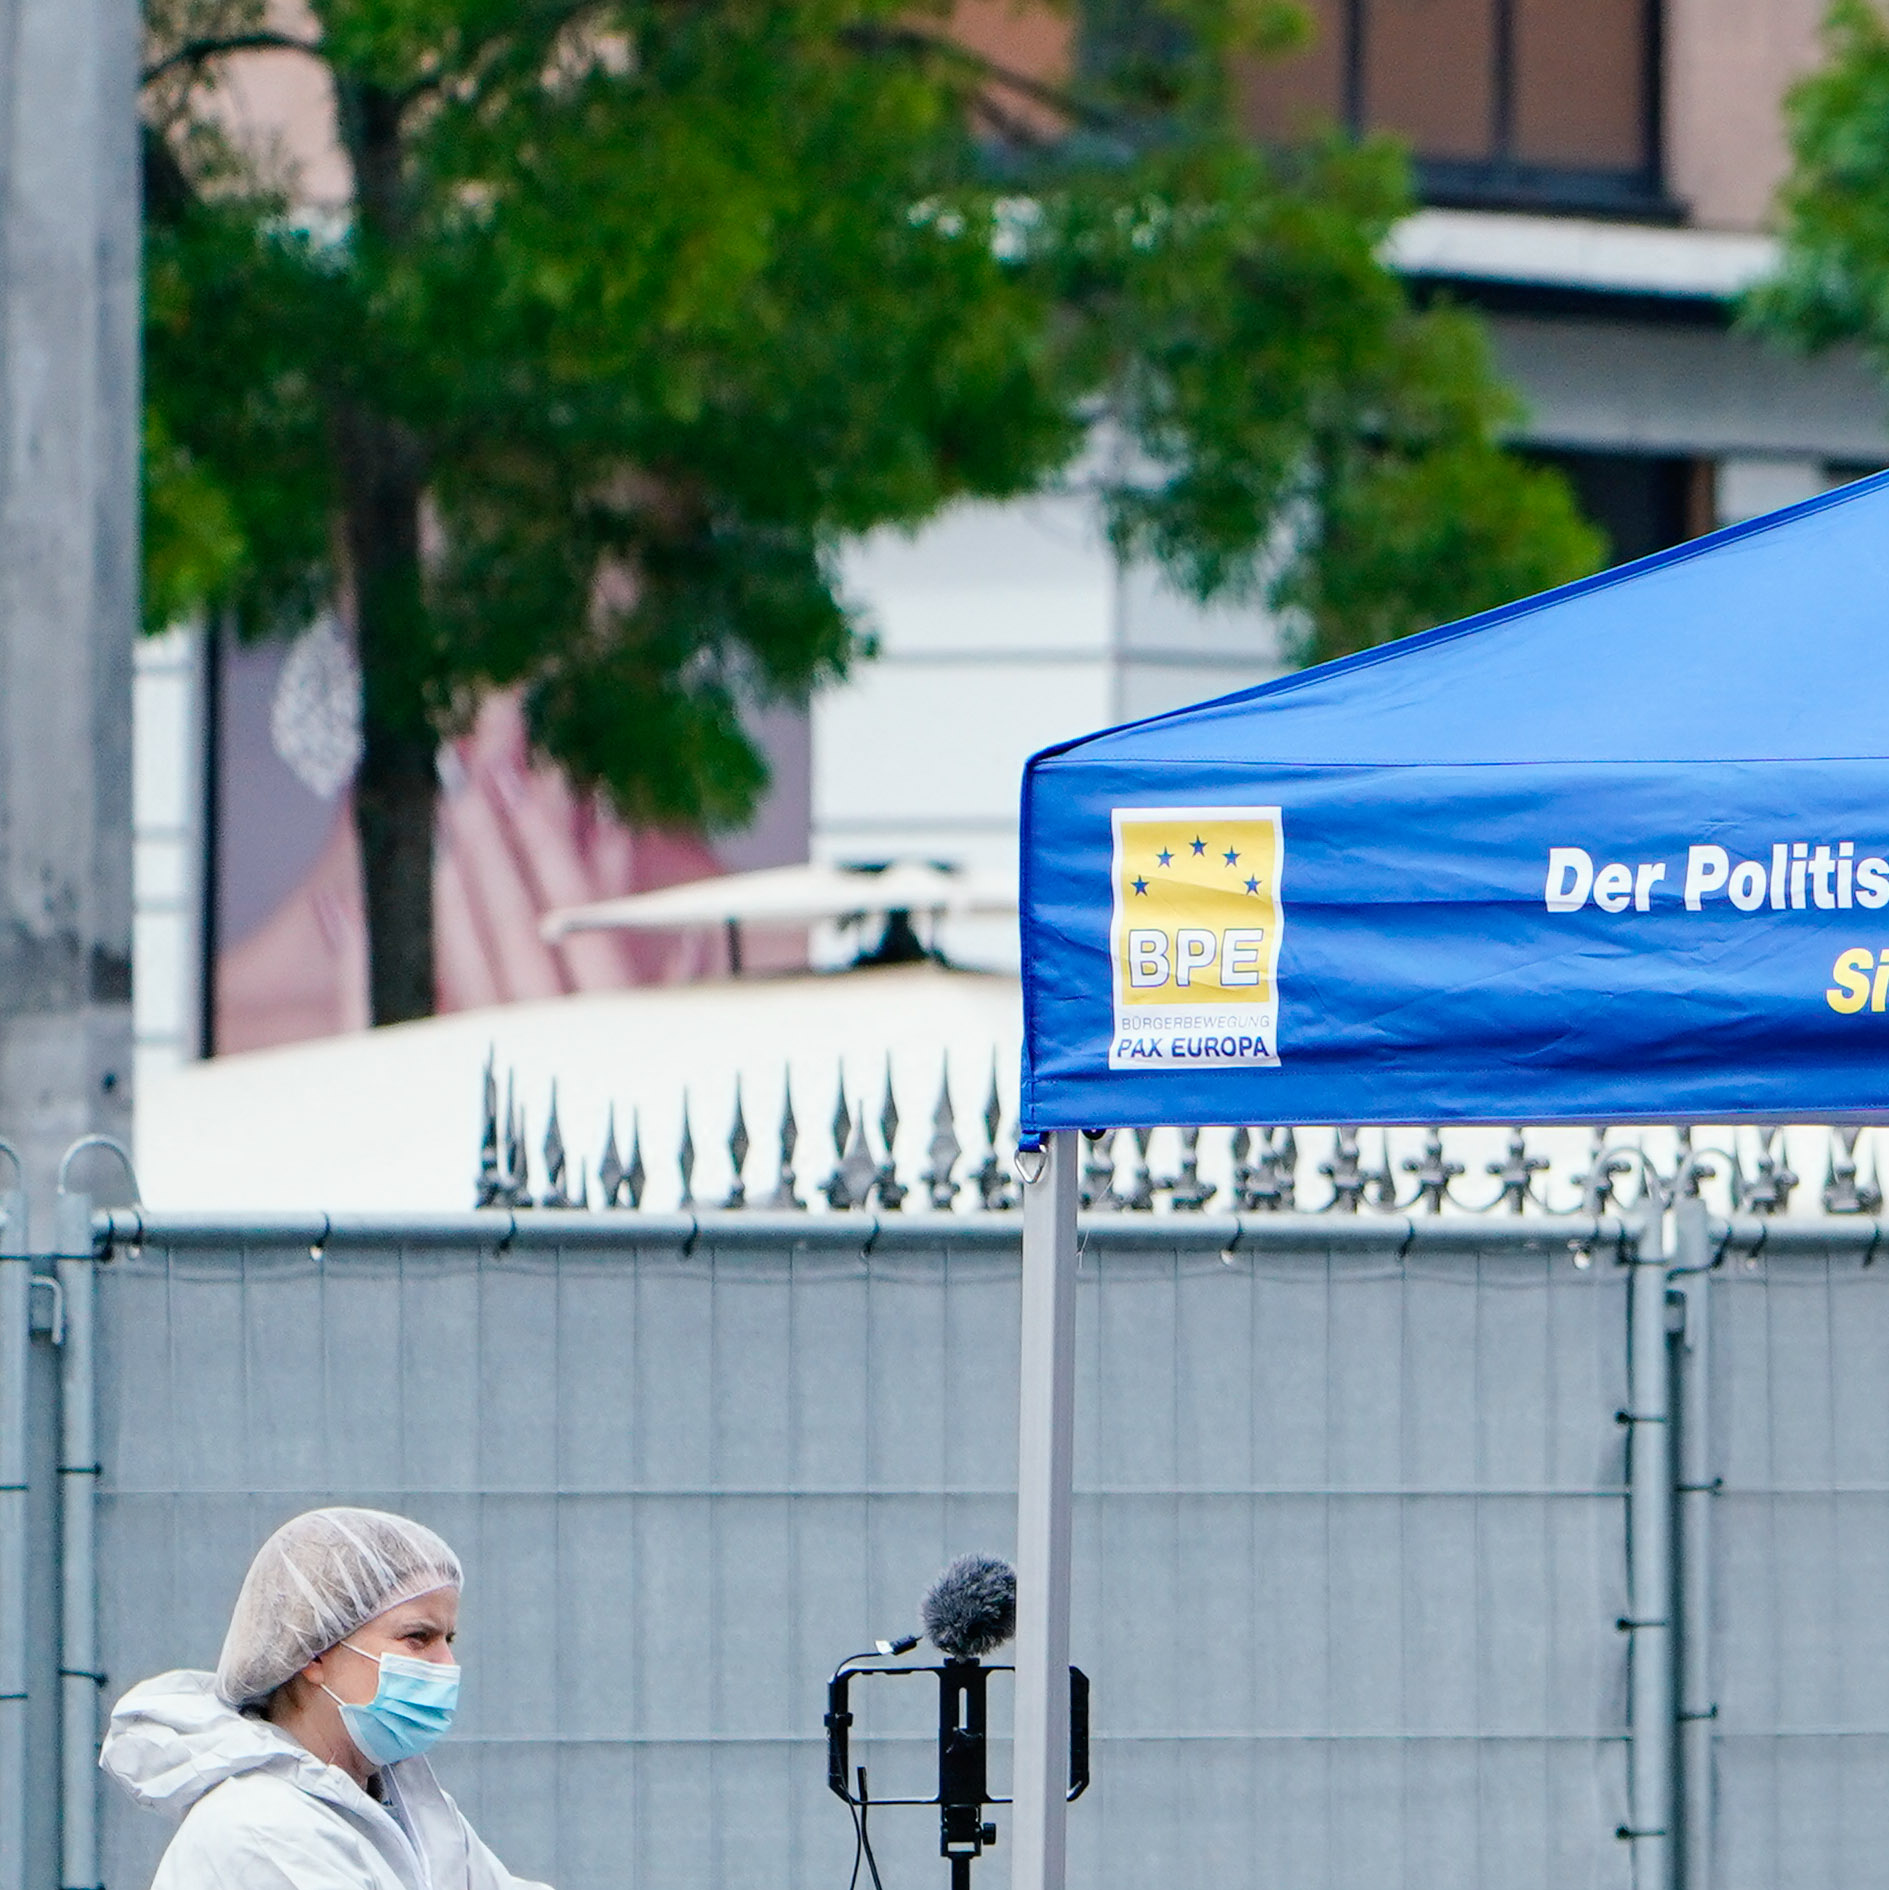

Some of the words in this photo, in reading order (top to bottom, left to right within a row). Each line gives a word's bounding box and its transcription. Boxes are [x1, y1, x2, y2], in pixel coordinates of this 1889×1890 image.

[1544, 846, 1656, 914] Der
[1129, 928, 1263, 987] BPE
[1122, 1015, 1270, 1030] BÜRGERBEWEGUNG
[1117, 1038, 1163, 1058] PAX
[1172, 1036, 1270, 1057] EUROPA
